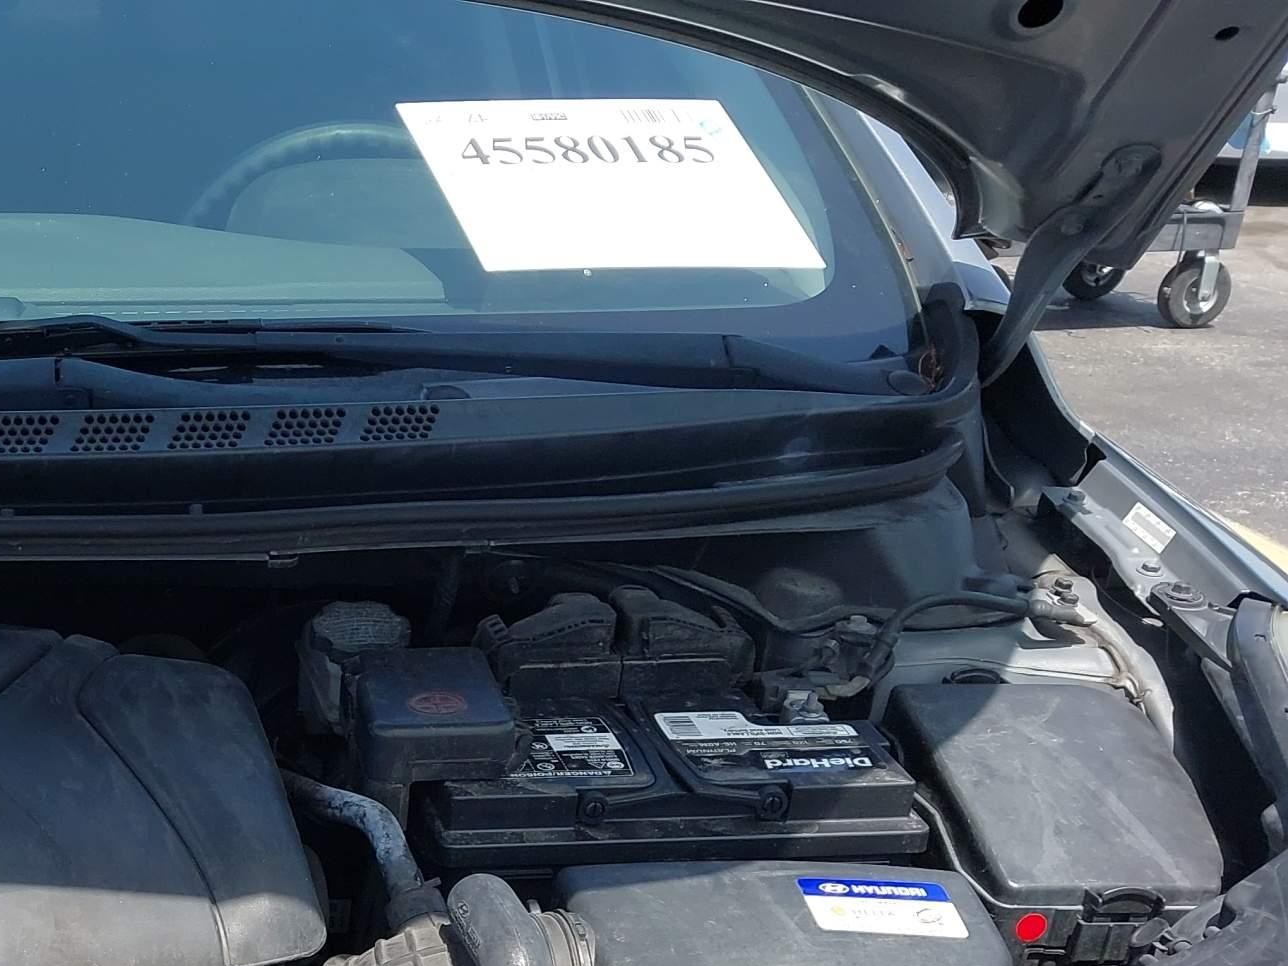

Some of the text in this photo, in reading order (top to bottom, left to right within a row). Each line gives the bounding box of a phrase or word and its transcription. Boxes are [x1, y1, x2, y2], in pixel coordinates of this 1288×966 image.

[460, 135, 716, 165] 45580185
[764, 756, 873, 770] DieHard
[852, 884, 928, 897] HYUNDAI
